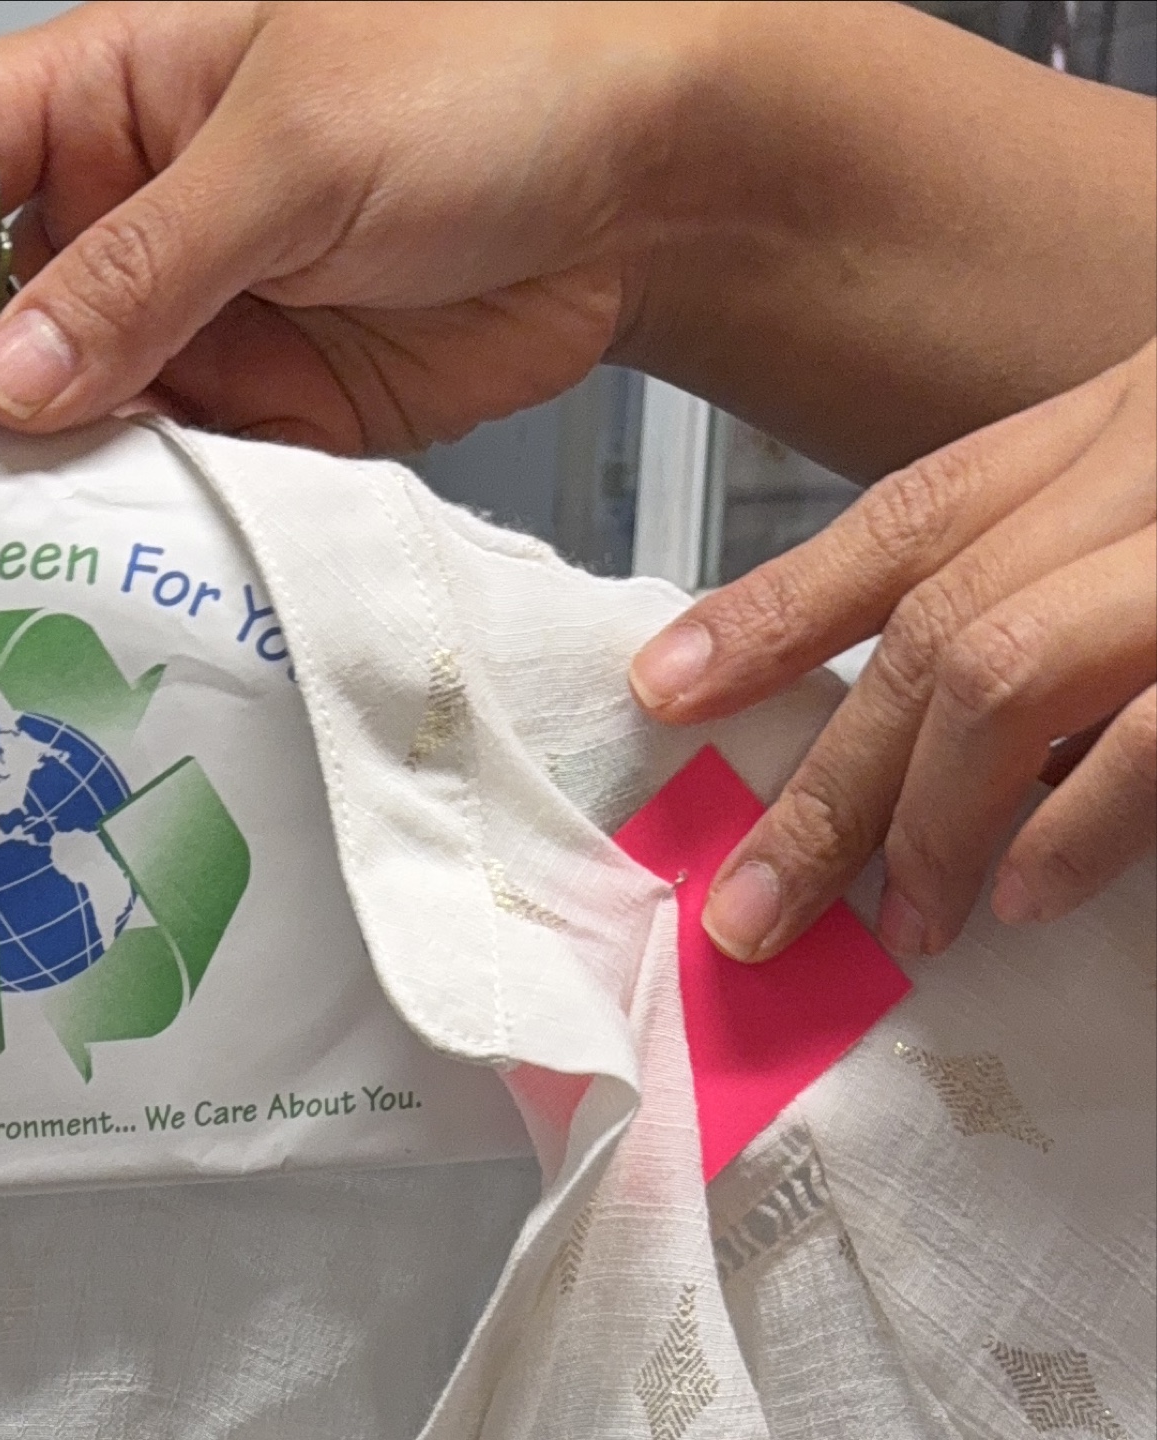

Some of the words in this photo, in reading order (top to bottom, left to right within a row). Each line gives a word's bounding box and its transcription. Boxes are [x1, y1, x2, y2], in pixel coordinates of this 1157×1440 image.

[120, 542, 221, 617] For
[236, 584, 299, 683] Yo
[144, 1104, 186, 1131] We
[194, 1101, 257, 1127] Care
[267, 1090, 356, 1120] About
[361, 1085, 422, 1112] You.
